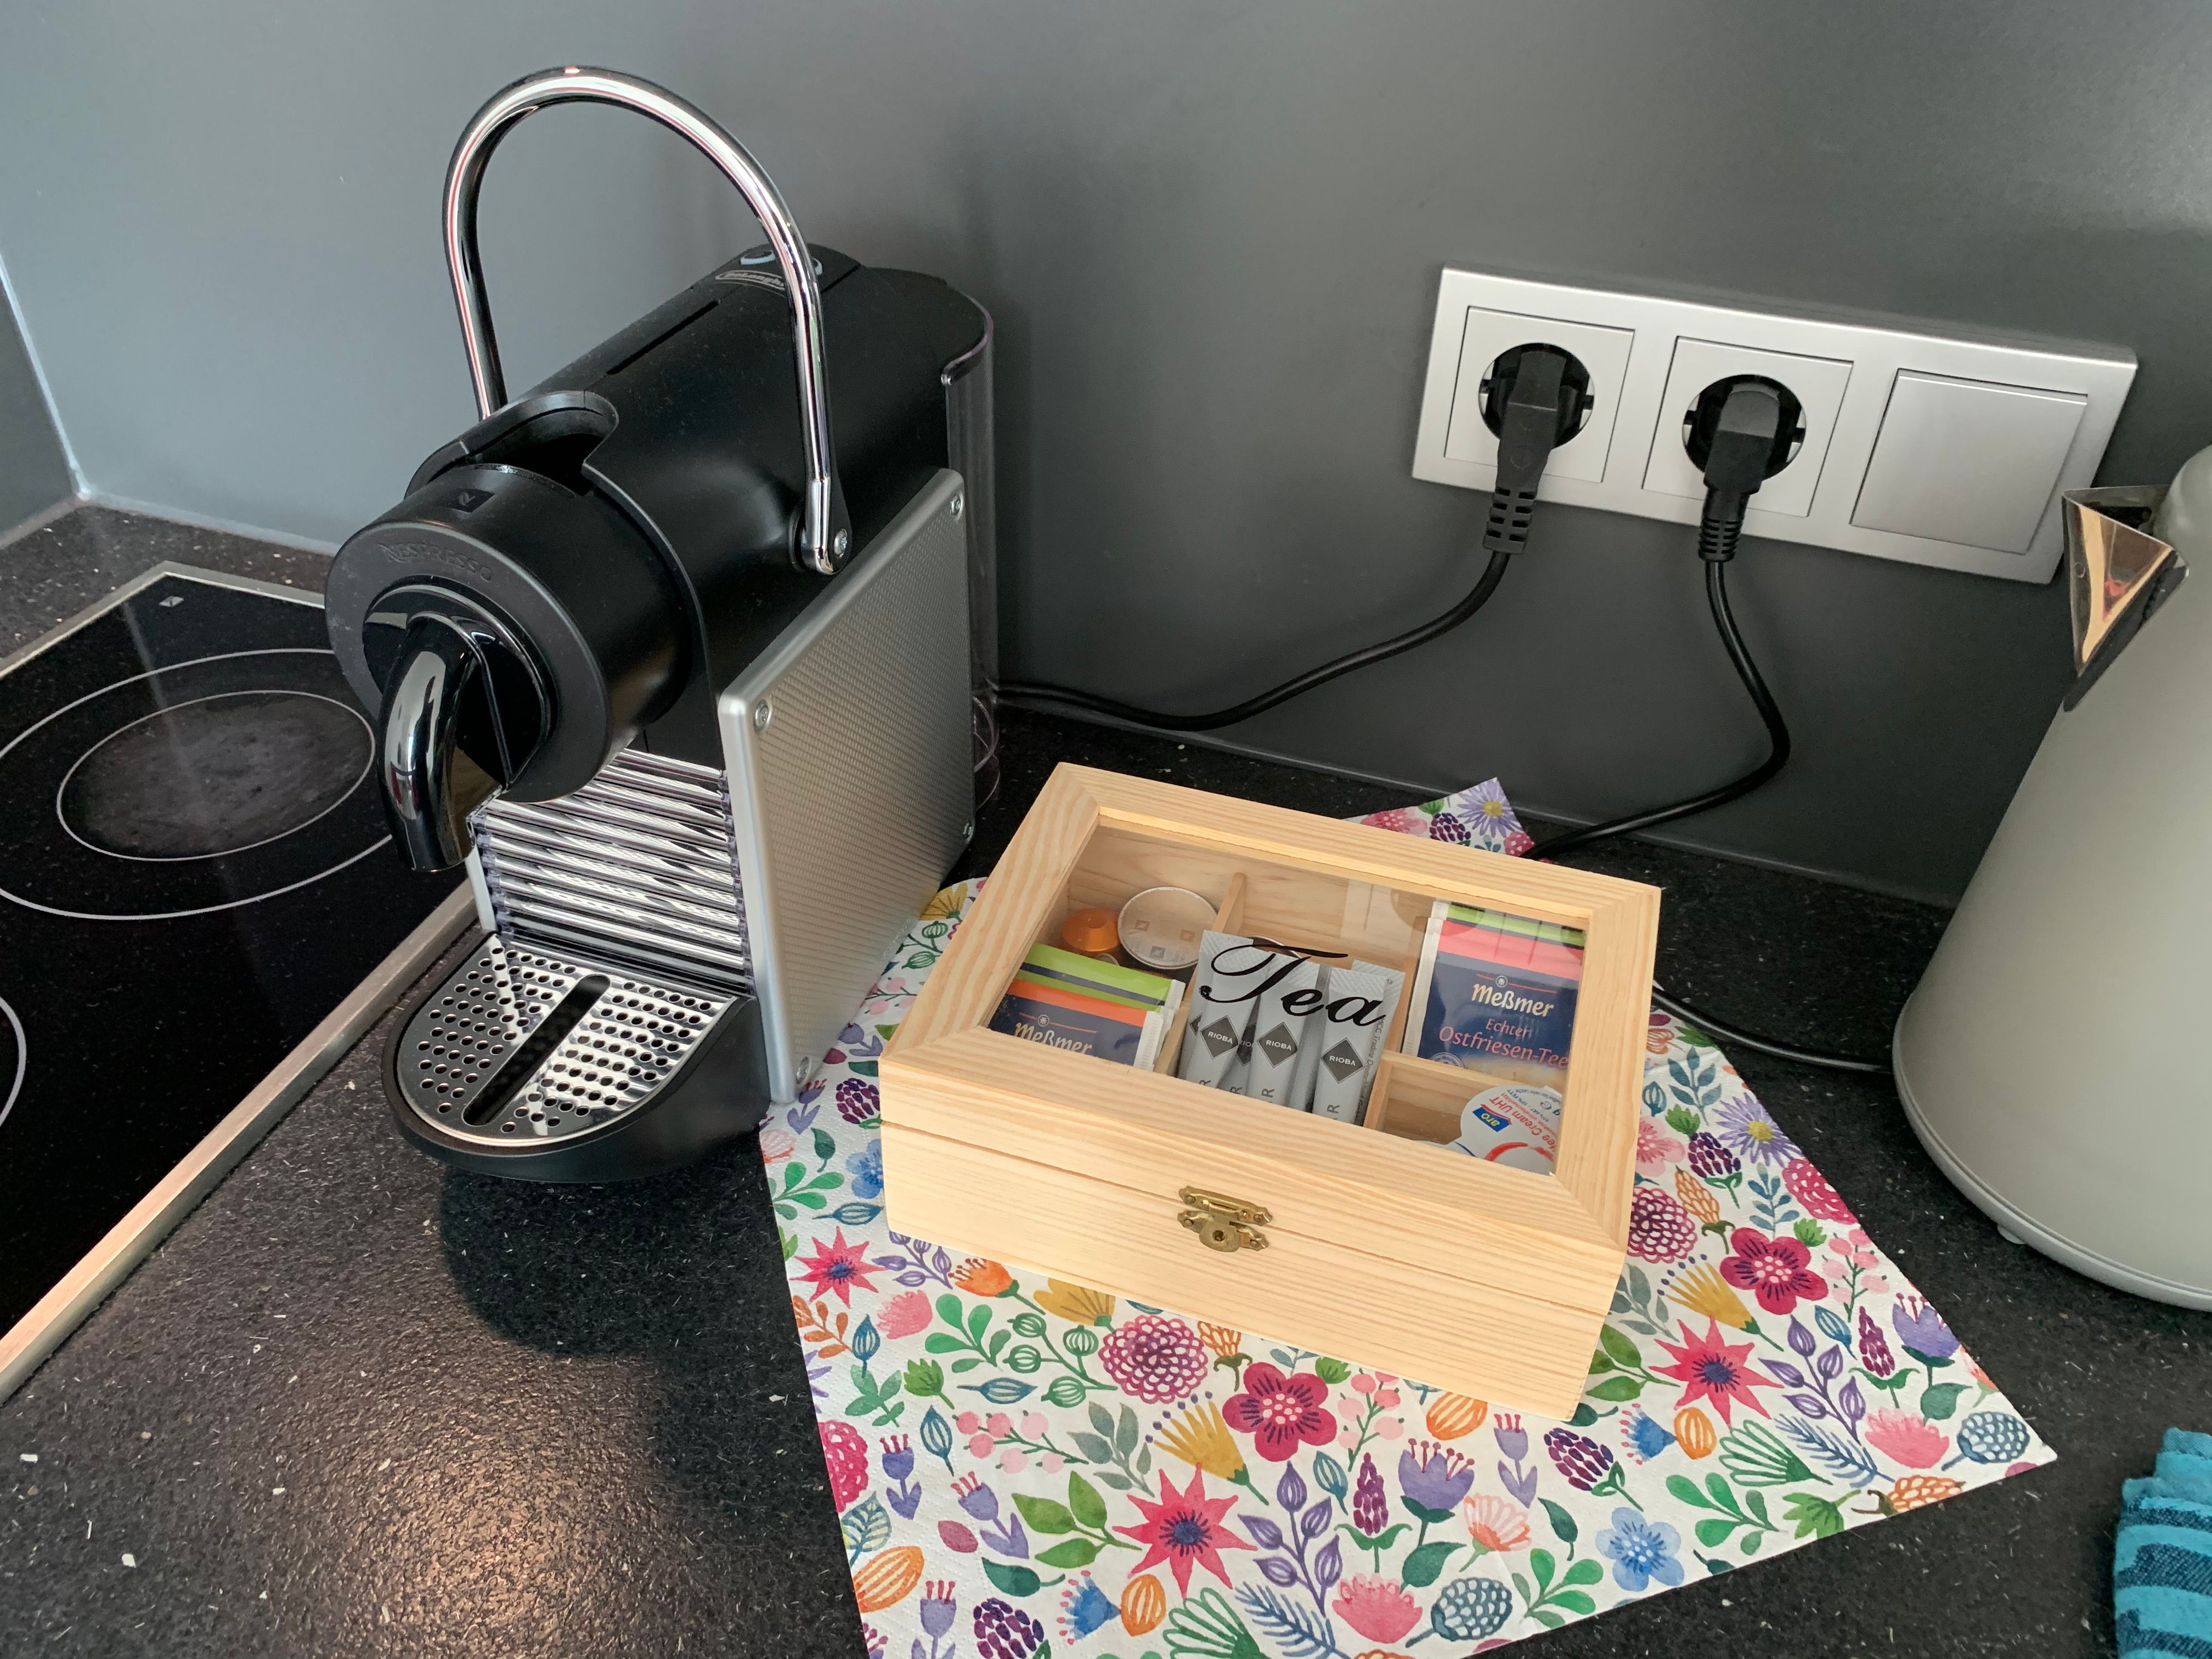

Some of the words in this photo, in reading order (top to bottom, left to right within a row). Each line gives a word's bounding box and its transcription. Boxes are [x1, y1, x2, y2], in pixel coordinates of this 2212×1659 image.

[1199, 944, 1386, 1026] Tea
[1471, 983, 1554, 1017] Meßmer
[1486, 1018, 1531, 1037] Echter
[1015, 1022, 1092, 1054] Meßmer
[1208, 1031, 1233, 1044] RIOBA
[1266, 1040, 1292, 1051] RIOBA
[1439, 1026, 1568, 1069] Ostfriesen-Tee
[1329, 1056, 1356, 1066] RIOBA
[1489, 1097, 1513, 1113] UHT
[1481, 1113, 1500, 1126] aro
[1512, 1111, 1542, 1136] Cream
[1542, 1135, 1556, 1152] fee
